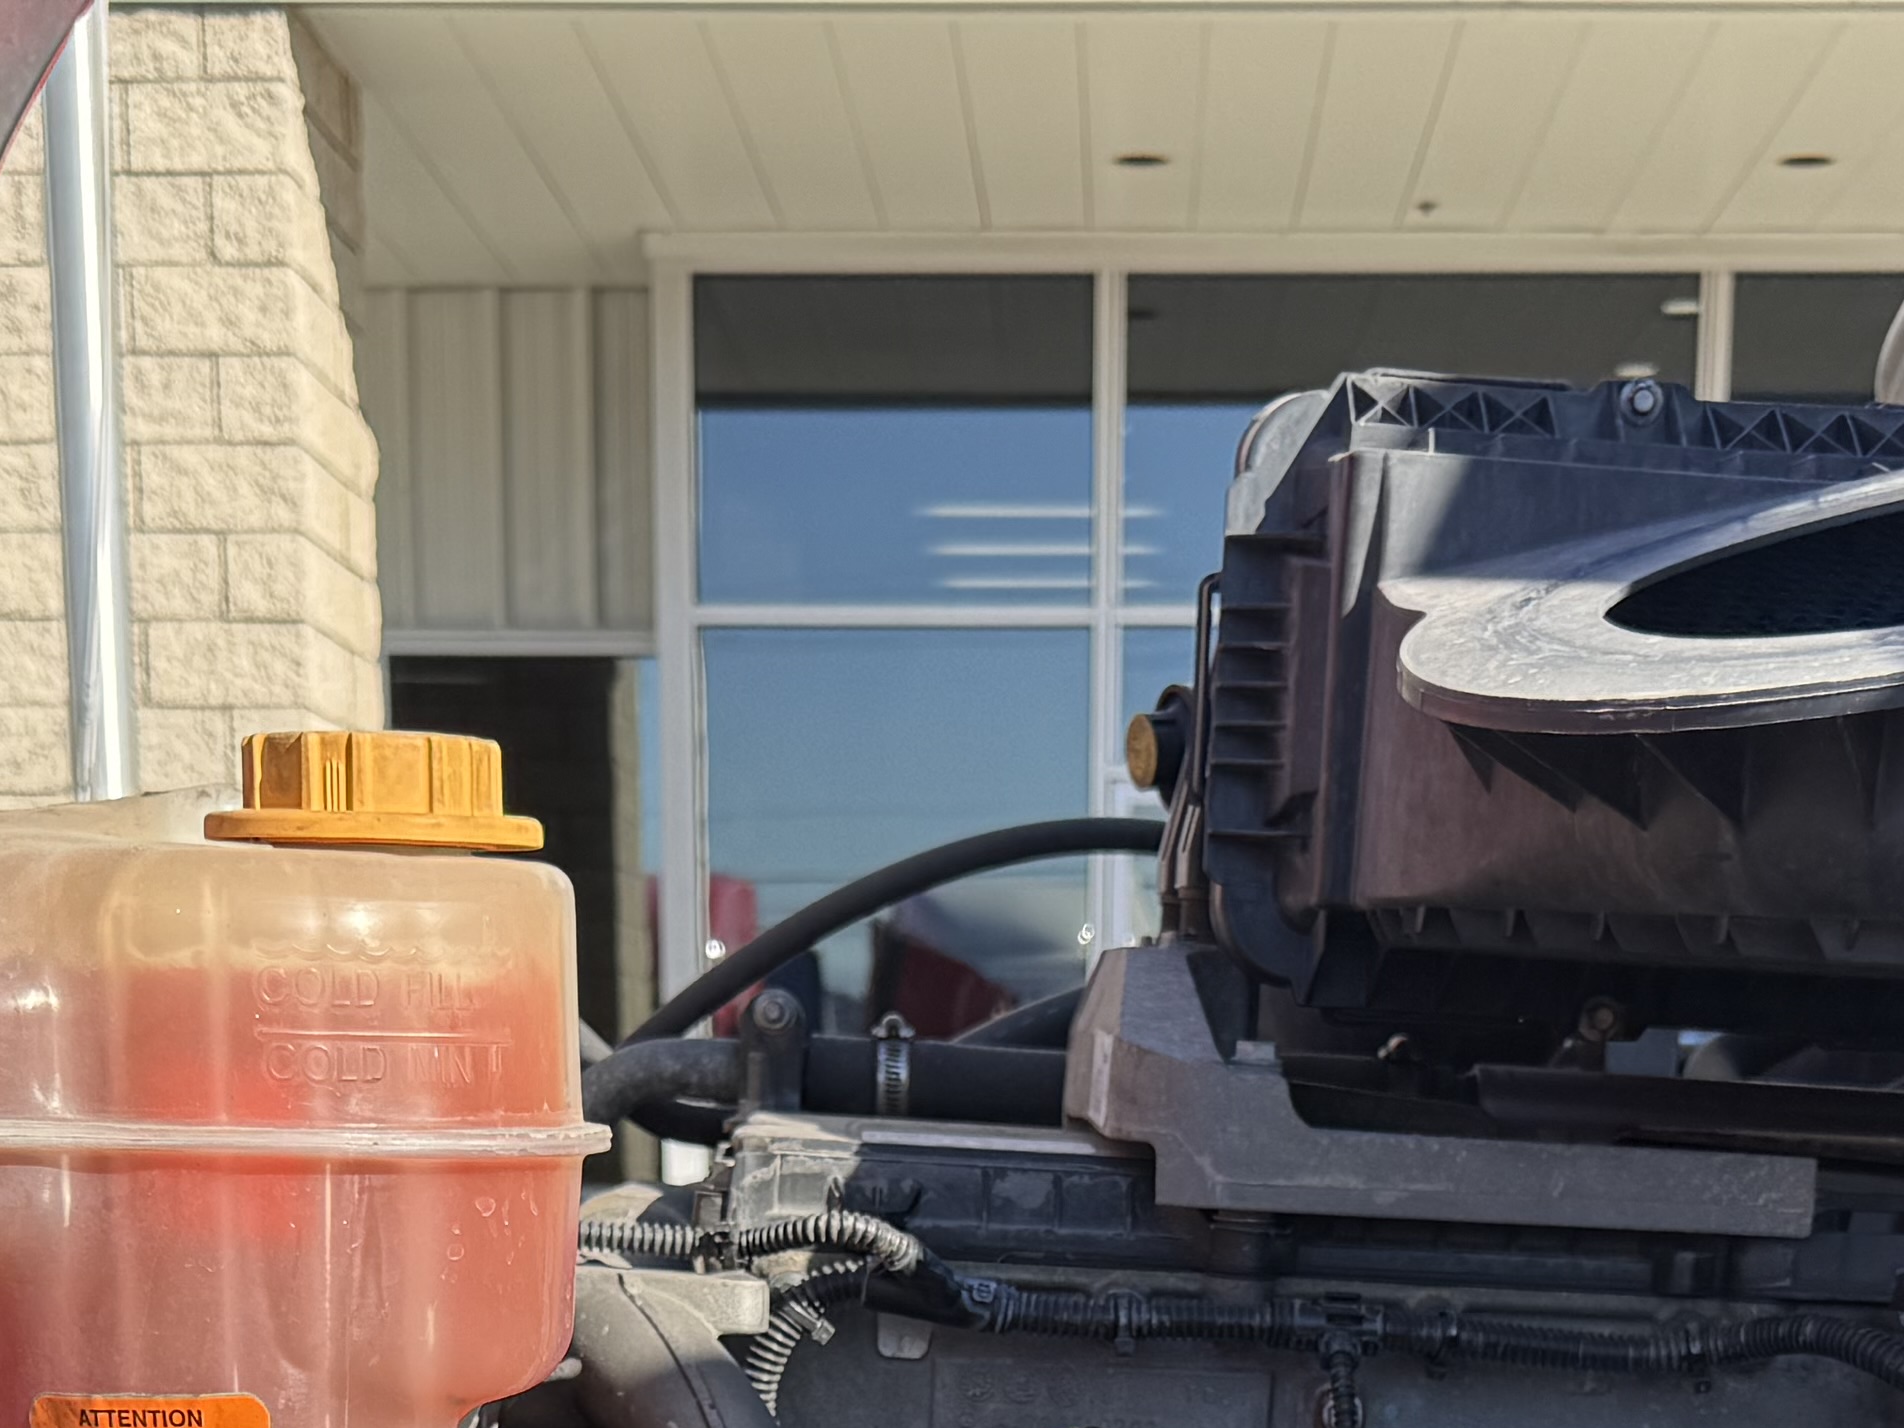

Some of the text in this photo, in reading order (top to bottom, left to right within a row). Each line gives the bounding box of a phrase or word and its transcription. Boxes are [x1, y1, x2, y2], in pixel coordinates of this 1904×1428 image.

[253, 966, 380, 1008] COLD
[266, 1043, 386, 1083] COLD
[79, 1409, 203, 1428] ATTENTION
